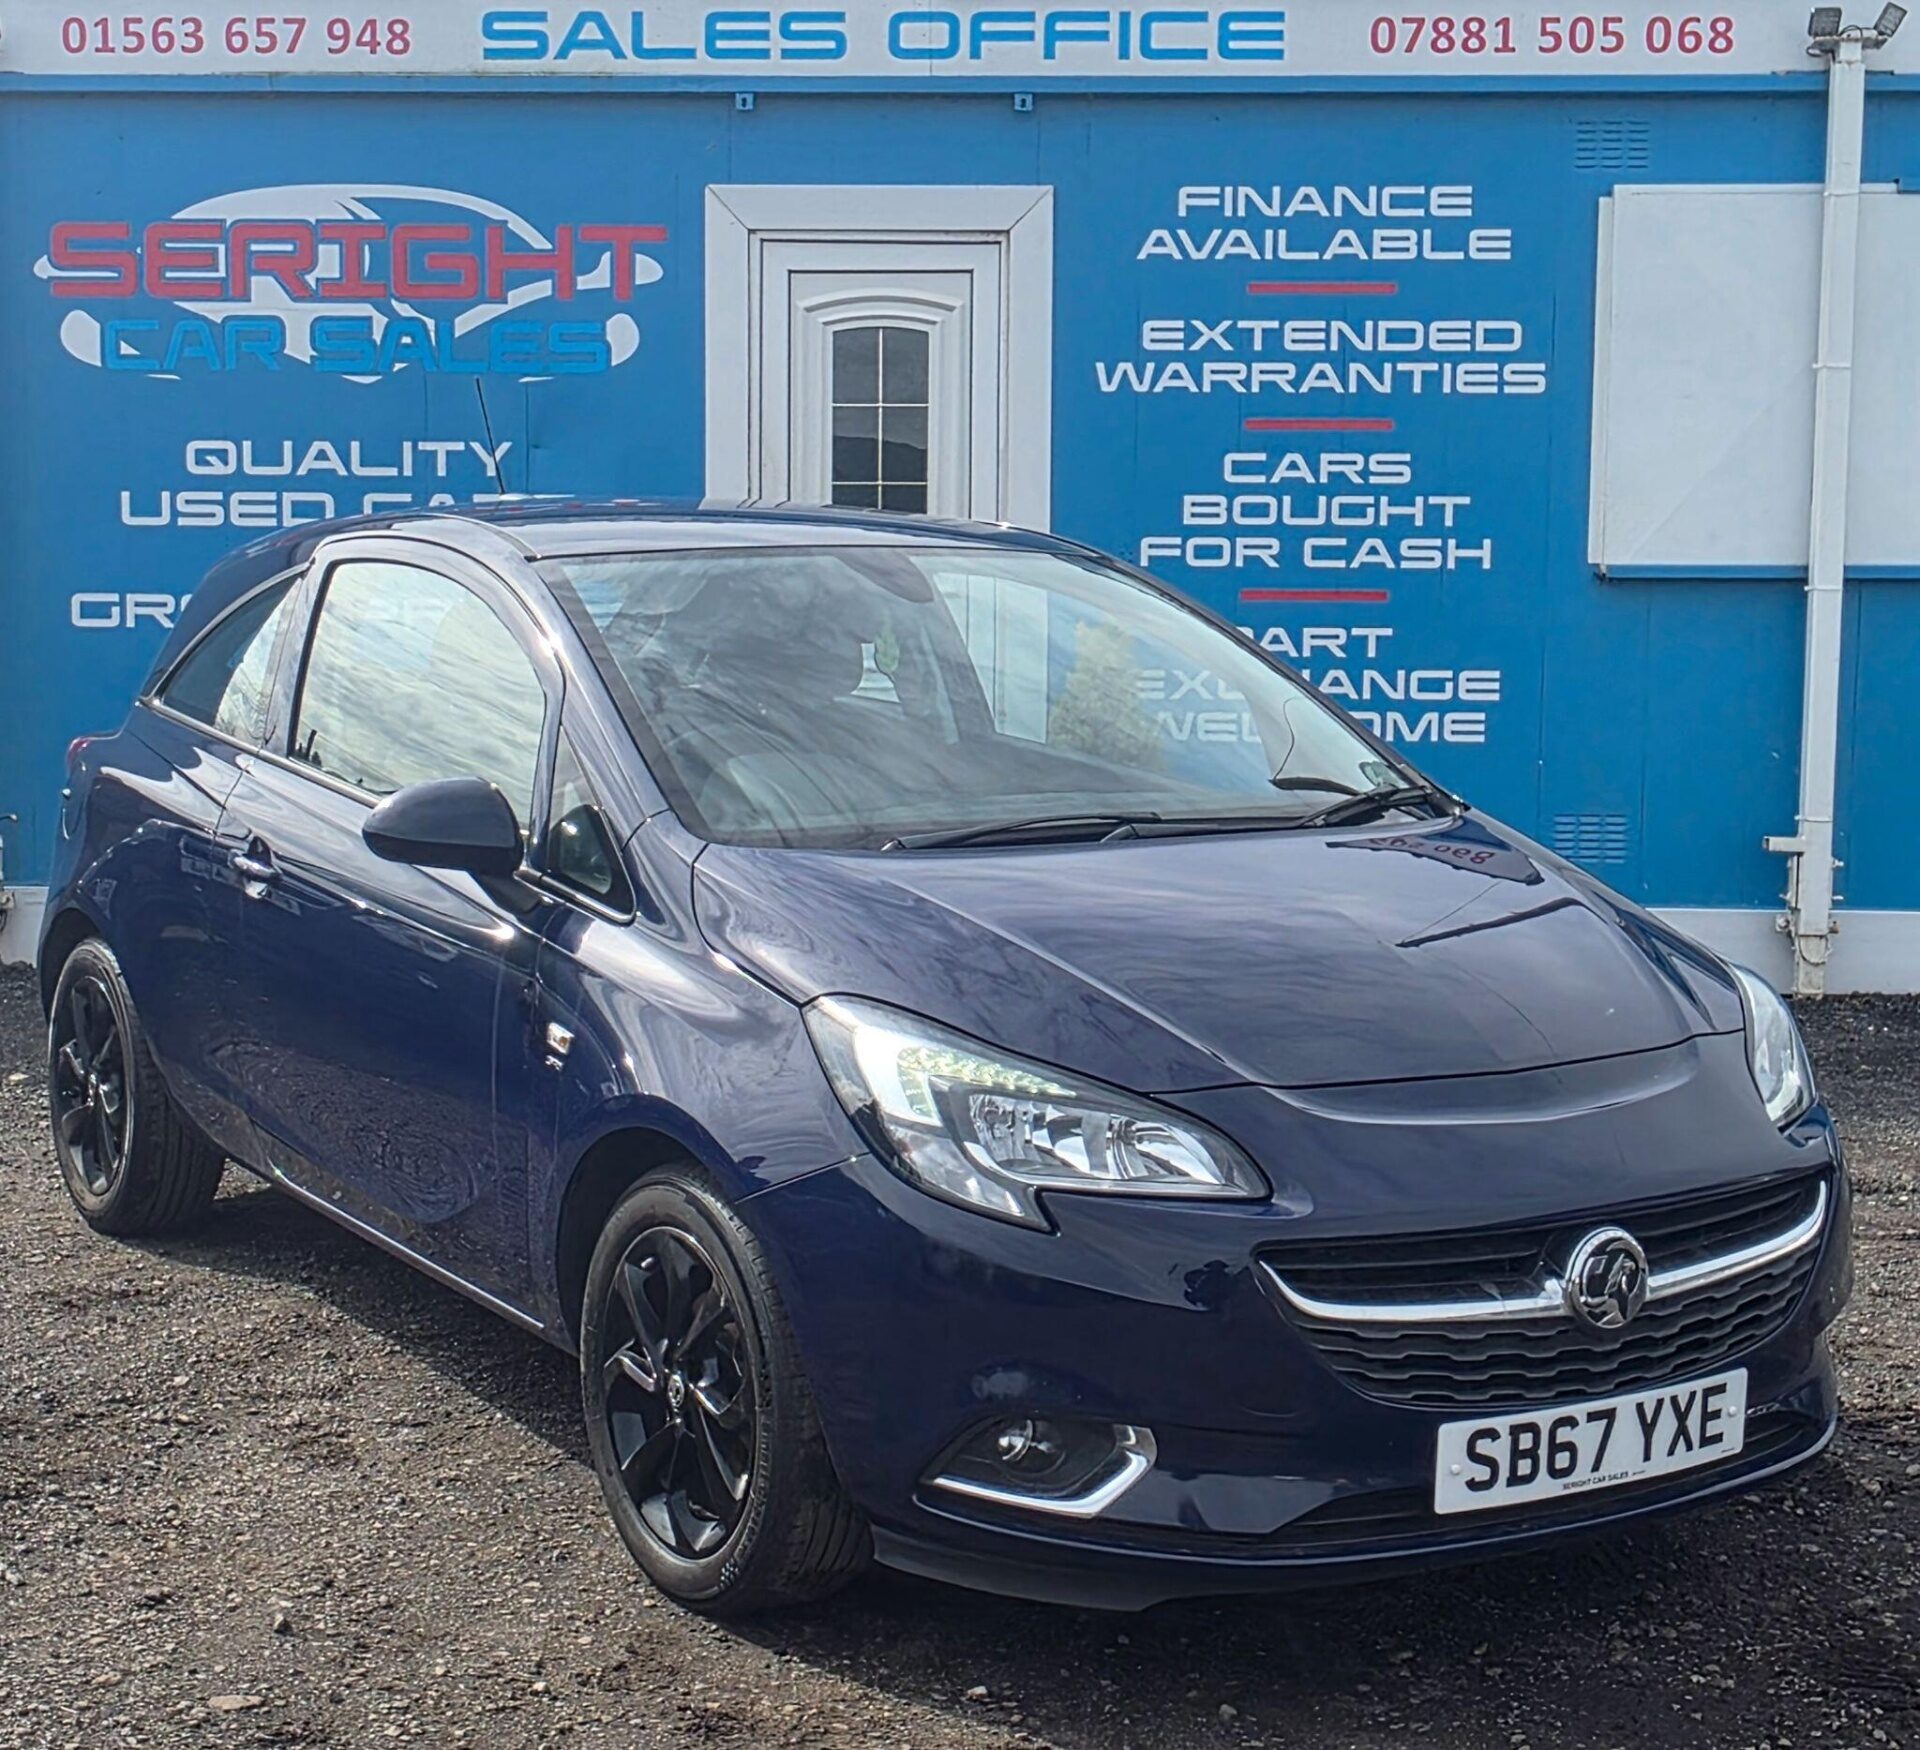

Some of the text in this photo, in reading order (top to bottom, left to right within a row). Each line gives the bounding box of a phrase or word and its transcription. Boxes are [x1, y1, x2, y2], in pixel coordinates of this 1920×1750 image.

[62, 17, 411, 56] 01563 657 948
[481, 11, 1286, 60] SALES OFFICE
[1370, 16, 1735, 54] 07881 505 068
[1178, 185, 1473, 217] FINANCE
[50, 222, 668, 300] SERIGHT
[1136, 228, 1512, 260] AVAILABLE
[105, 318, 608, 373] CAR SALES
[1142, 320, 1522, 352] EXTENDED
[1095, 362, 1546, 394] WARRANTIES
[186, 440, 512, 477] QUALITY
[1224, 452, 1411, 484] CARS
[121, 490, 335, 527] USED
[1183, 495, 1471, 527] BOUGHT
[1140, 536, 1491, 569] FOR CASH
[71, 592, 193, 628] GR
[1236, 627, 1393, 658] ART
[1464, 1382, 1728, 1493] SB67 YXE
